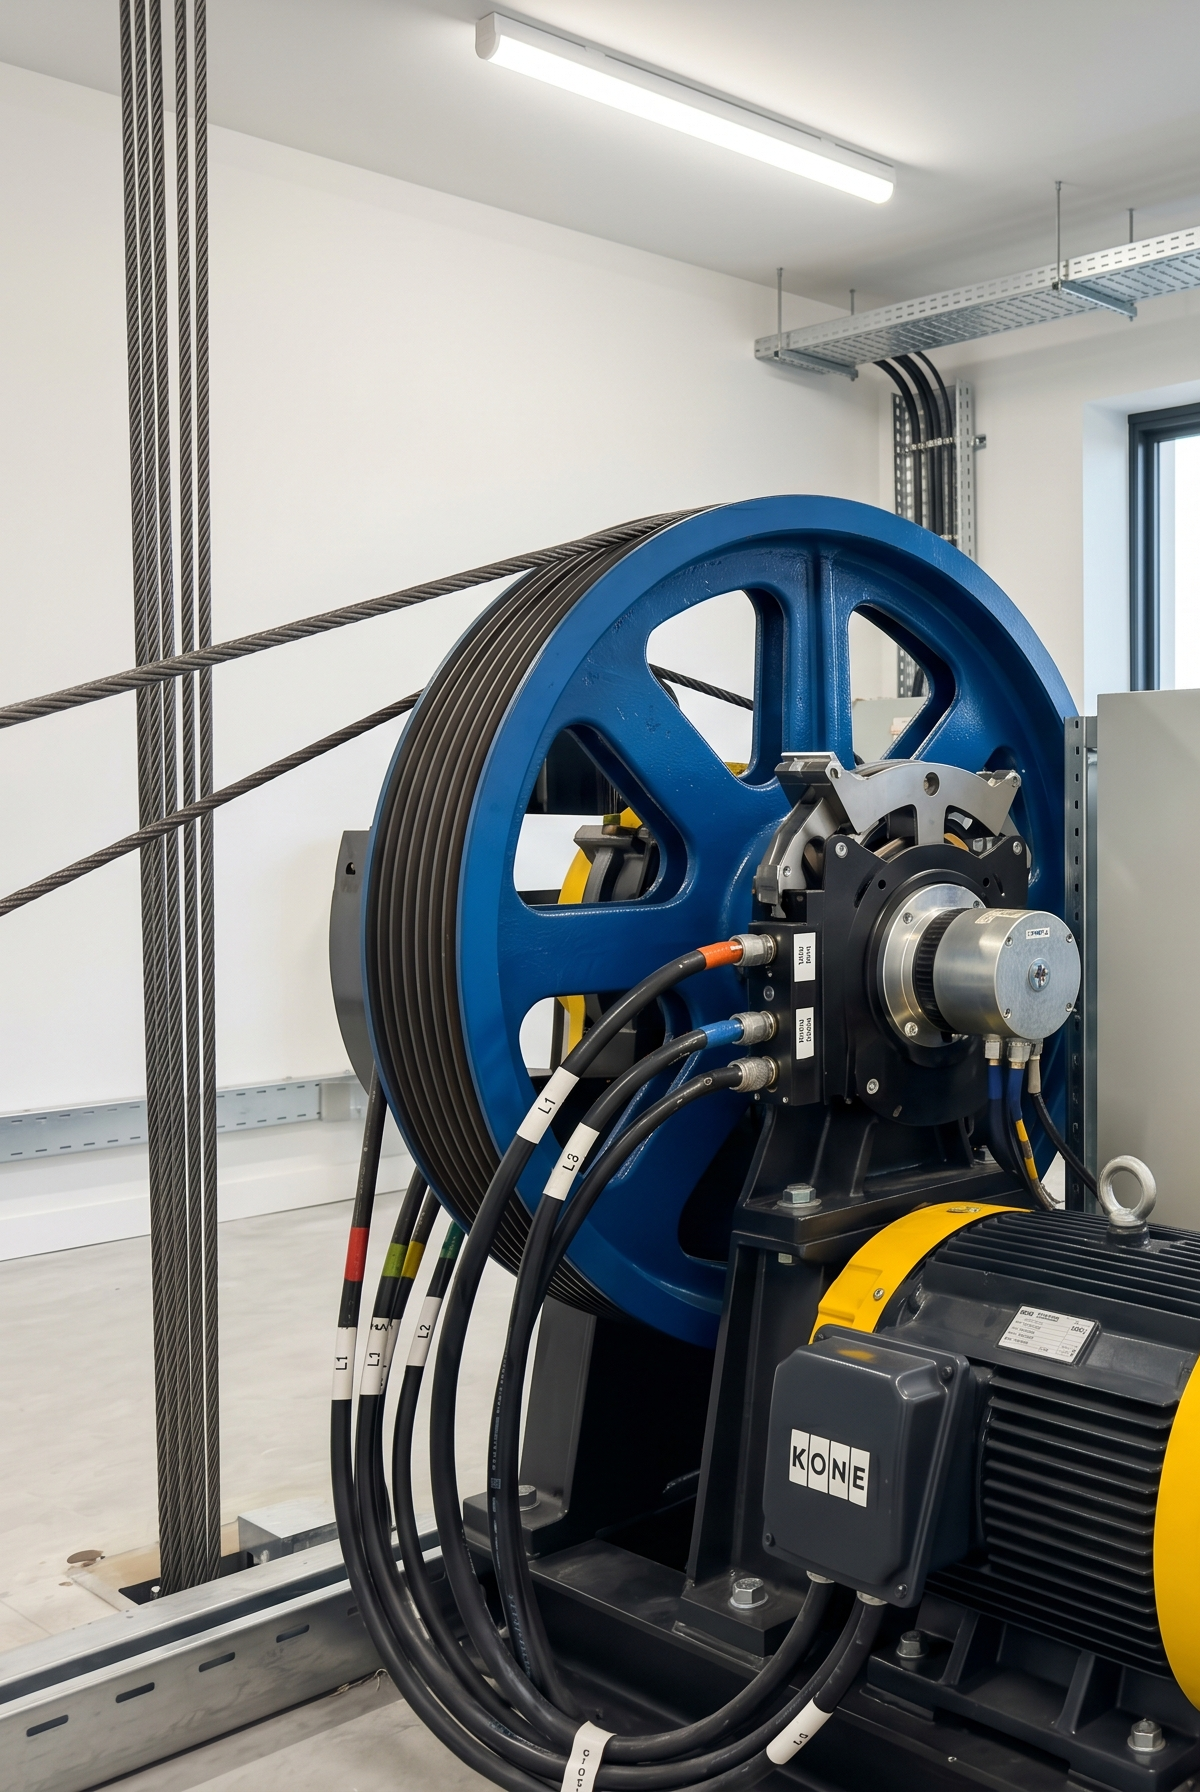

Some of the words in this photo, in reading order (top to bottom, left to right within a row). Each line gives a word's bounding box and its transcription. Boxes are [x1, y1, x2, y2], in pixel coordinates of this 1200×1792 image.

[537, 1097, 556, 1115] L1
[417, 1324, 431, 1339] L2
[335, 1356, 348, 1370] L1
[792, 1445, 866, 1491] KONE
